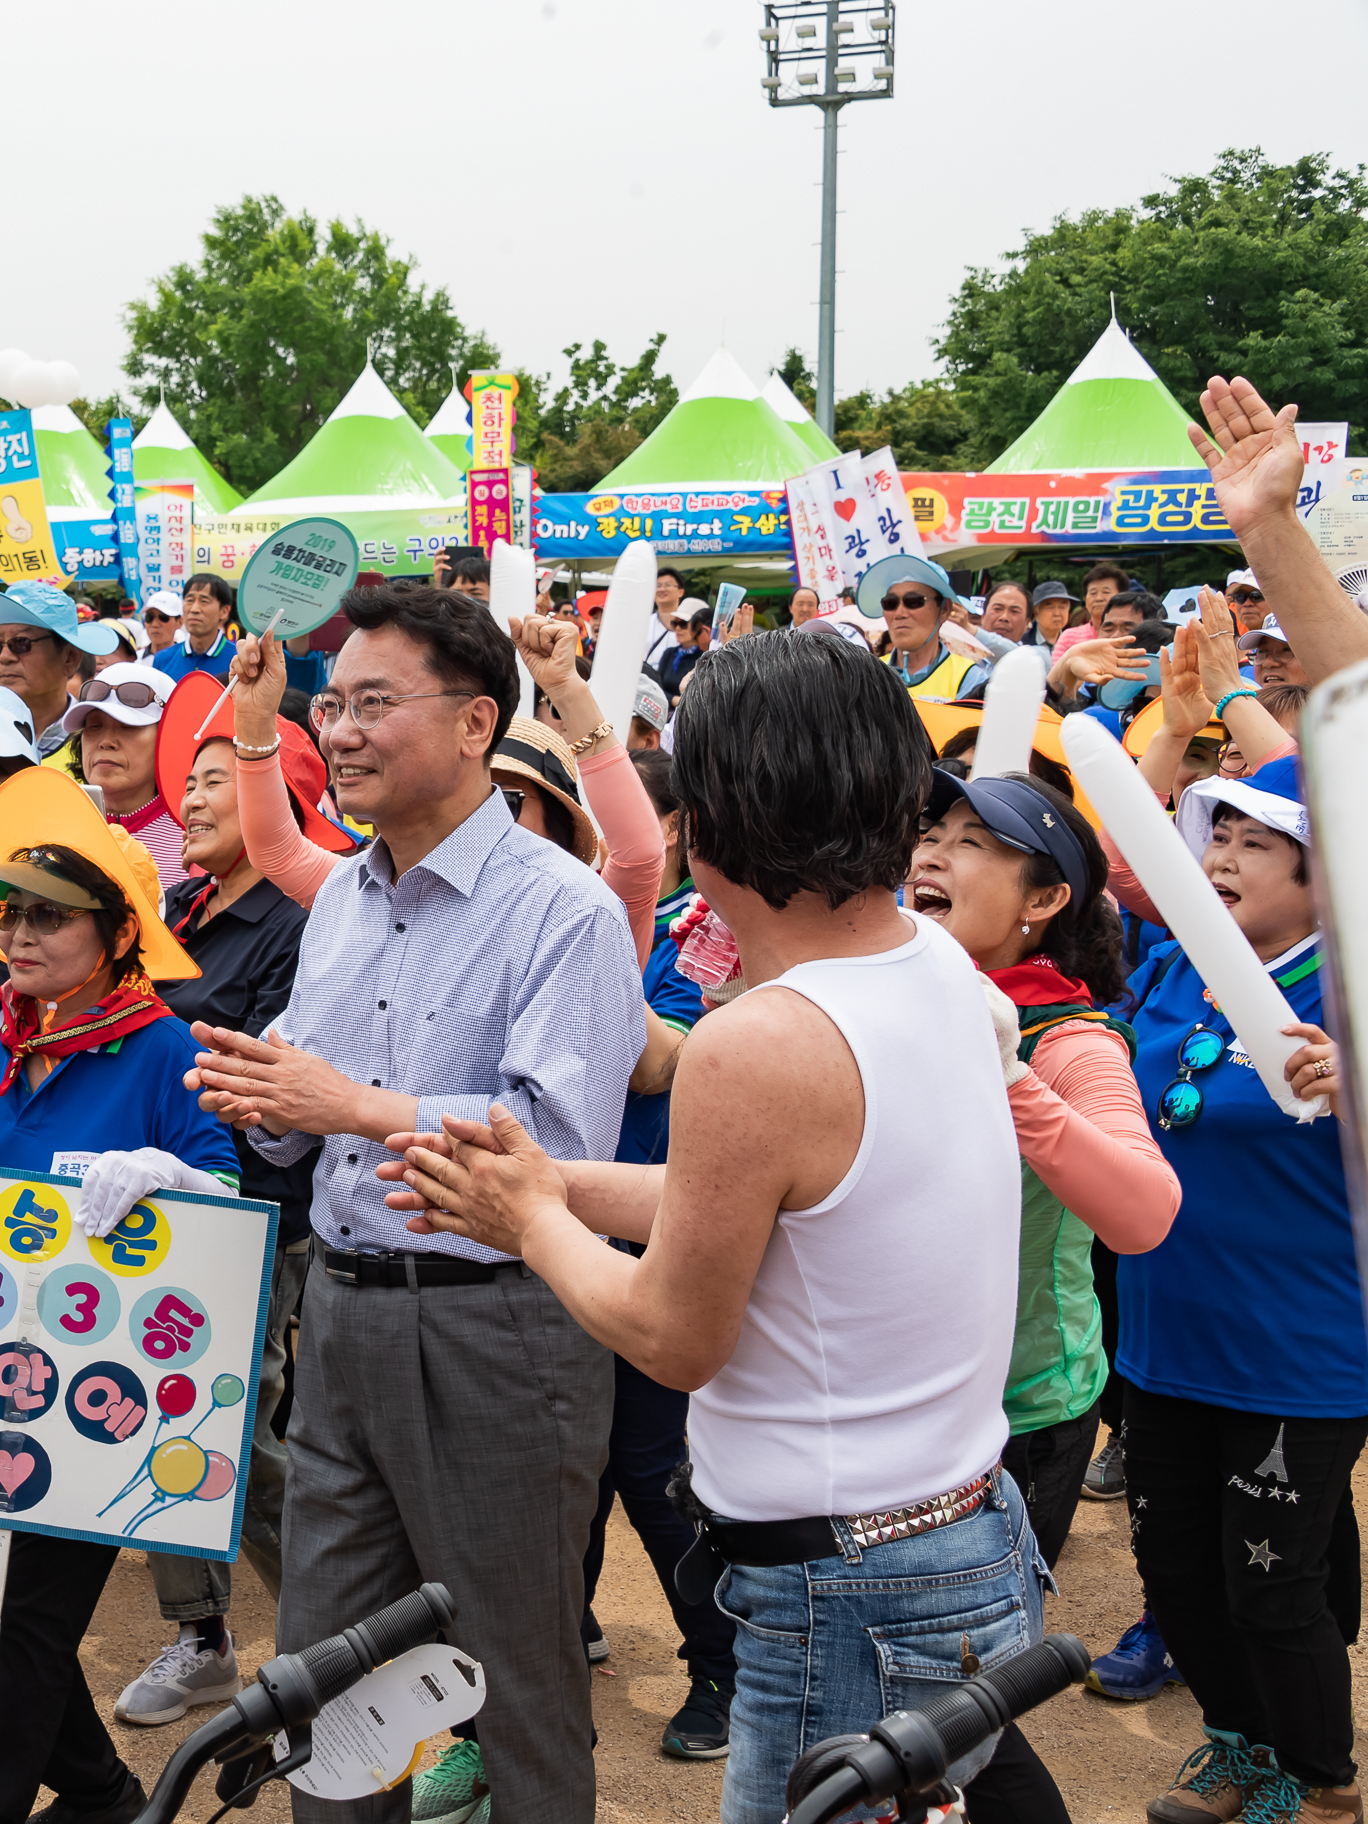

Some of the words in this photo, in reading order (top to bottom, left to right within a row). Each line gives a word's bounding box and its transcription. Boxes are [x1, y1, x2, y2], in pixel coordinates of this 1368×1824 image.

[537, 518, 590, 540] Only
[596, 516, 653, 538] 광진!
[661, 518, 723, 536] First
[878, 508, 903, 548] 광
[911, 496, 934, 522] 필
[965, 499, 1027, 530] 광진
[1035, 499, 1102, 531] 제일
[304, 532, 337, 553] 2019
[269, 560, 330, 592] 가입자모집!
